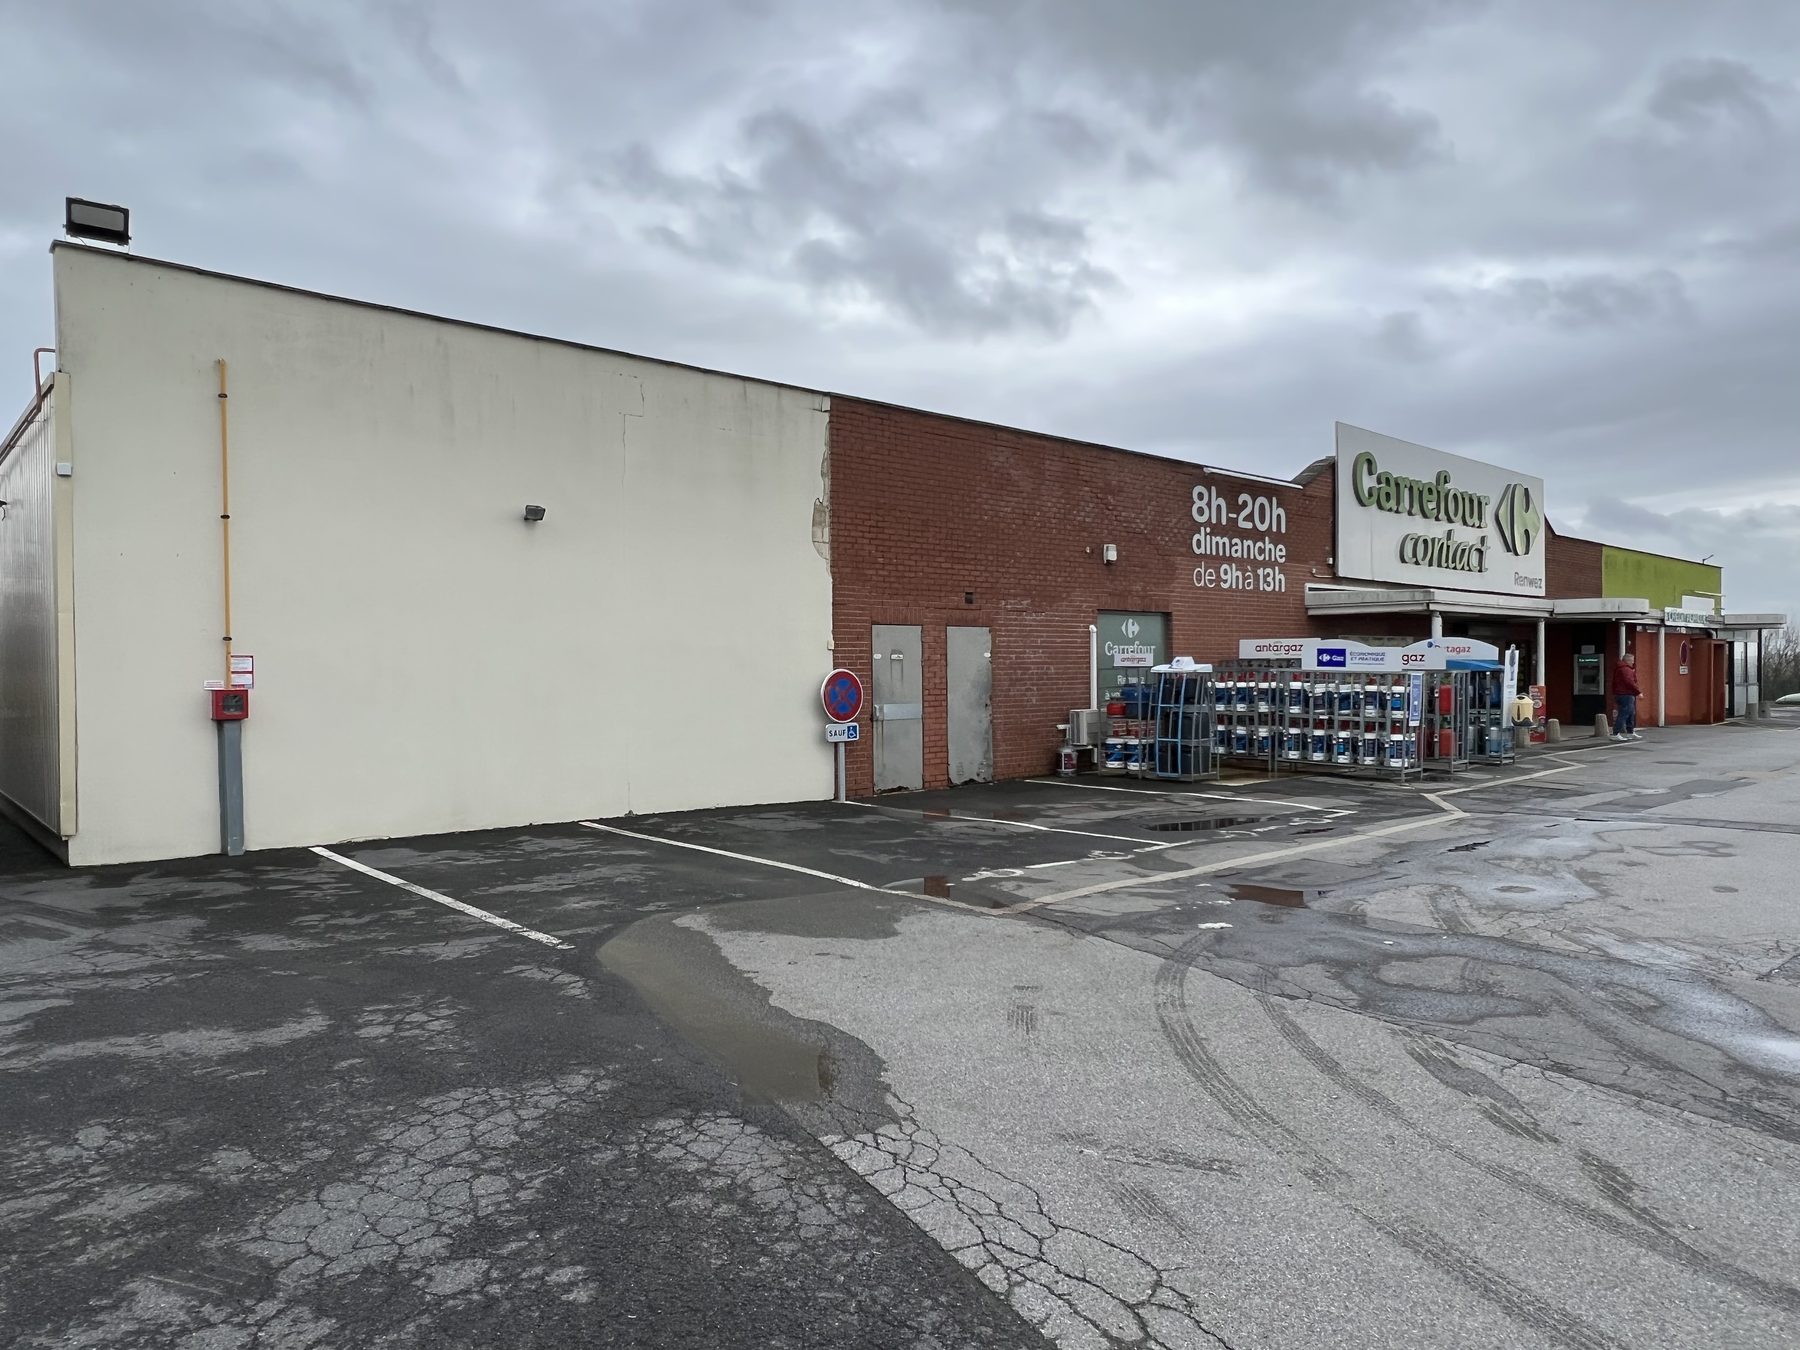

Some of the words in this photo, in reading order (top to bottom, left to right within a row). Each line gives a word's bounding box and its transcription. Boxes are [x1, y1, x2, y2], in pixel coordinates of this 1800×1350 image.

[1352, 451, 1490, 529] Carrefour
[1191, 485, 1286, 534] 8h-20h
[1192, 526, 1287, 564] dimanche
[1398, 529, 1491, 573] contact
[1193, 561, 1216, 588] de
[1257, 566, 1285, 592] 13h
[1514, 571, 1543, 589] Renwez
[1105, 641, 1156, 656] Carrefour
[1255, 643, 1304, 655] antargaz
[828, 729, 846, 737] SAUF
